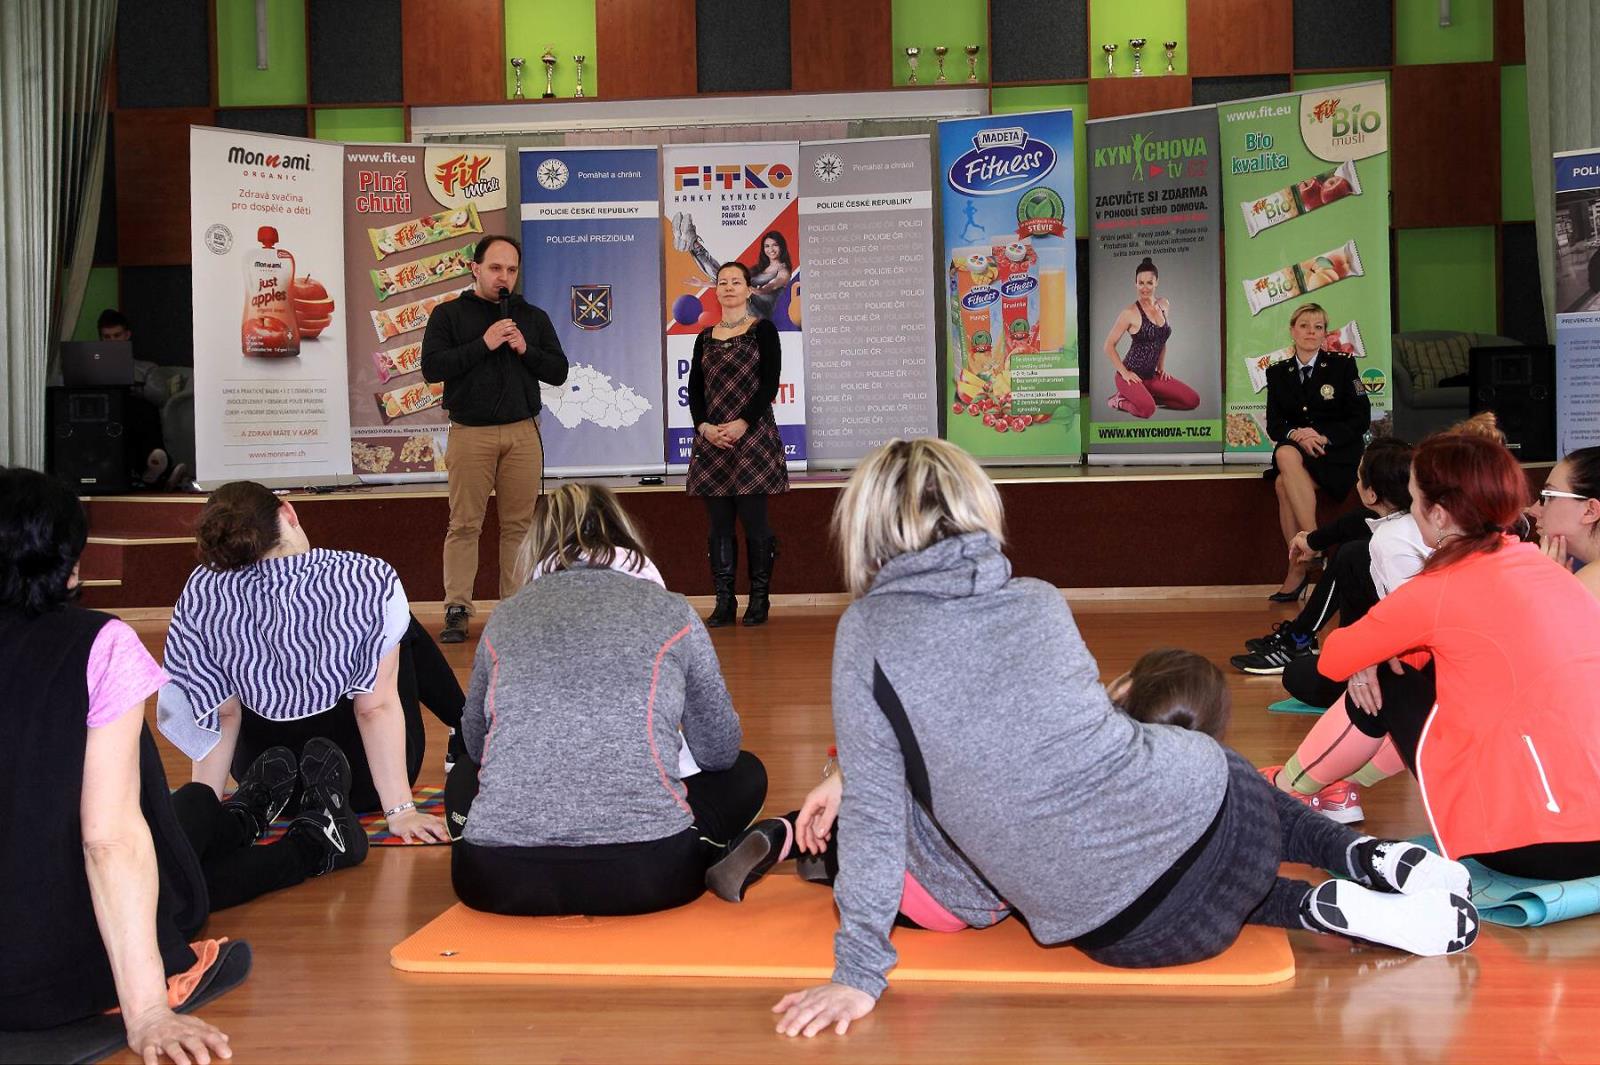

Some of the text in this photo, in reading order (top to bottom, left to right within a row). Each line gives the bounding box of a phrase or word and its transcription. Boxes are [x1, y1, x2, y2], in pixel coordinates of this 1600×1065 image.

[1227, 105, 1292, 123] www.fit.eu
[1332, 104, 1381, 138] Bio
[982, 131, 1020, 144] MADETA
[1244, 132, 1273, 151] Bio
[347, 152, 416, 164] www.fit.eu
[1231, 151, 1289, 174] kvalita
[965, 150, 1043, 184] Fitness
[1573, 166, 1600, 177] POLI
[243, 170, 297, 182] ORGANIC
[358, 170, 407, 193] Plná
[435, 153, 492, 197] Fit
[578, 171, 610, 180] Pomáhat
[239, 188, 303, 203] Zdravá svačina
[355, 192, 412, 213] chuti
[674, 192, 791, 202] HANKY KYNYCHOVÉ
[1095, 185, 1208, 207] ZACVIČTE SI ZDARMA
[231, 201, 248, 211] pro
[294, 205, 311, 215] děti
[539, 206, 639, 216] POLICIE ČESKÉ REPUBLIKY
[816, 198, 912, 209] POLICIE ČESKÉ REPUBLIKY
[1095, 201, 1208, 220] V POHODLÍ SVÉHO DOMOVA.
[546, 234, 635, 243] POLICEJNÍ PREZIDIUM
[259, 276, 278, 292] just
[251, 289, 287, 307] apples
[1099, 426, 1211, 439] WWW.KYNYCHOVA-TV.CZ
